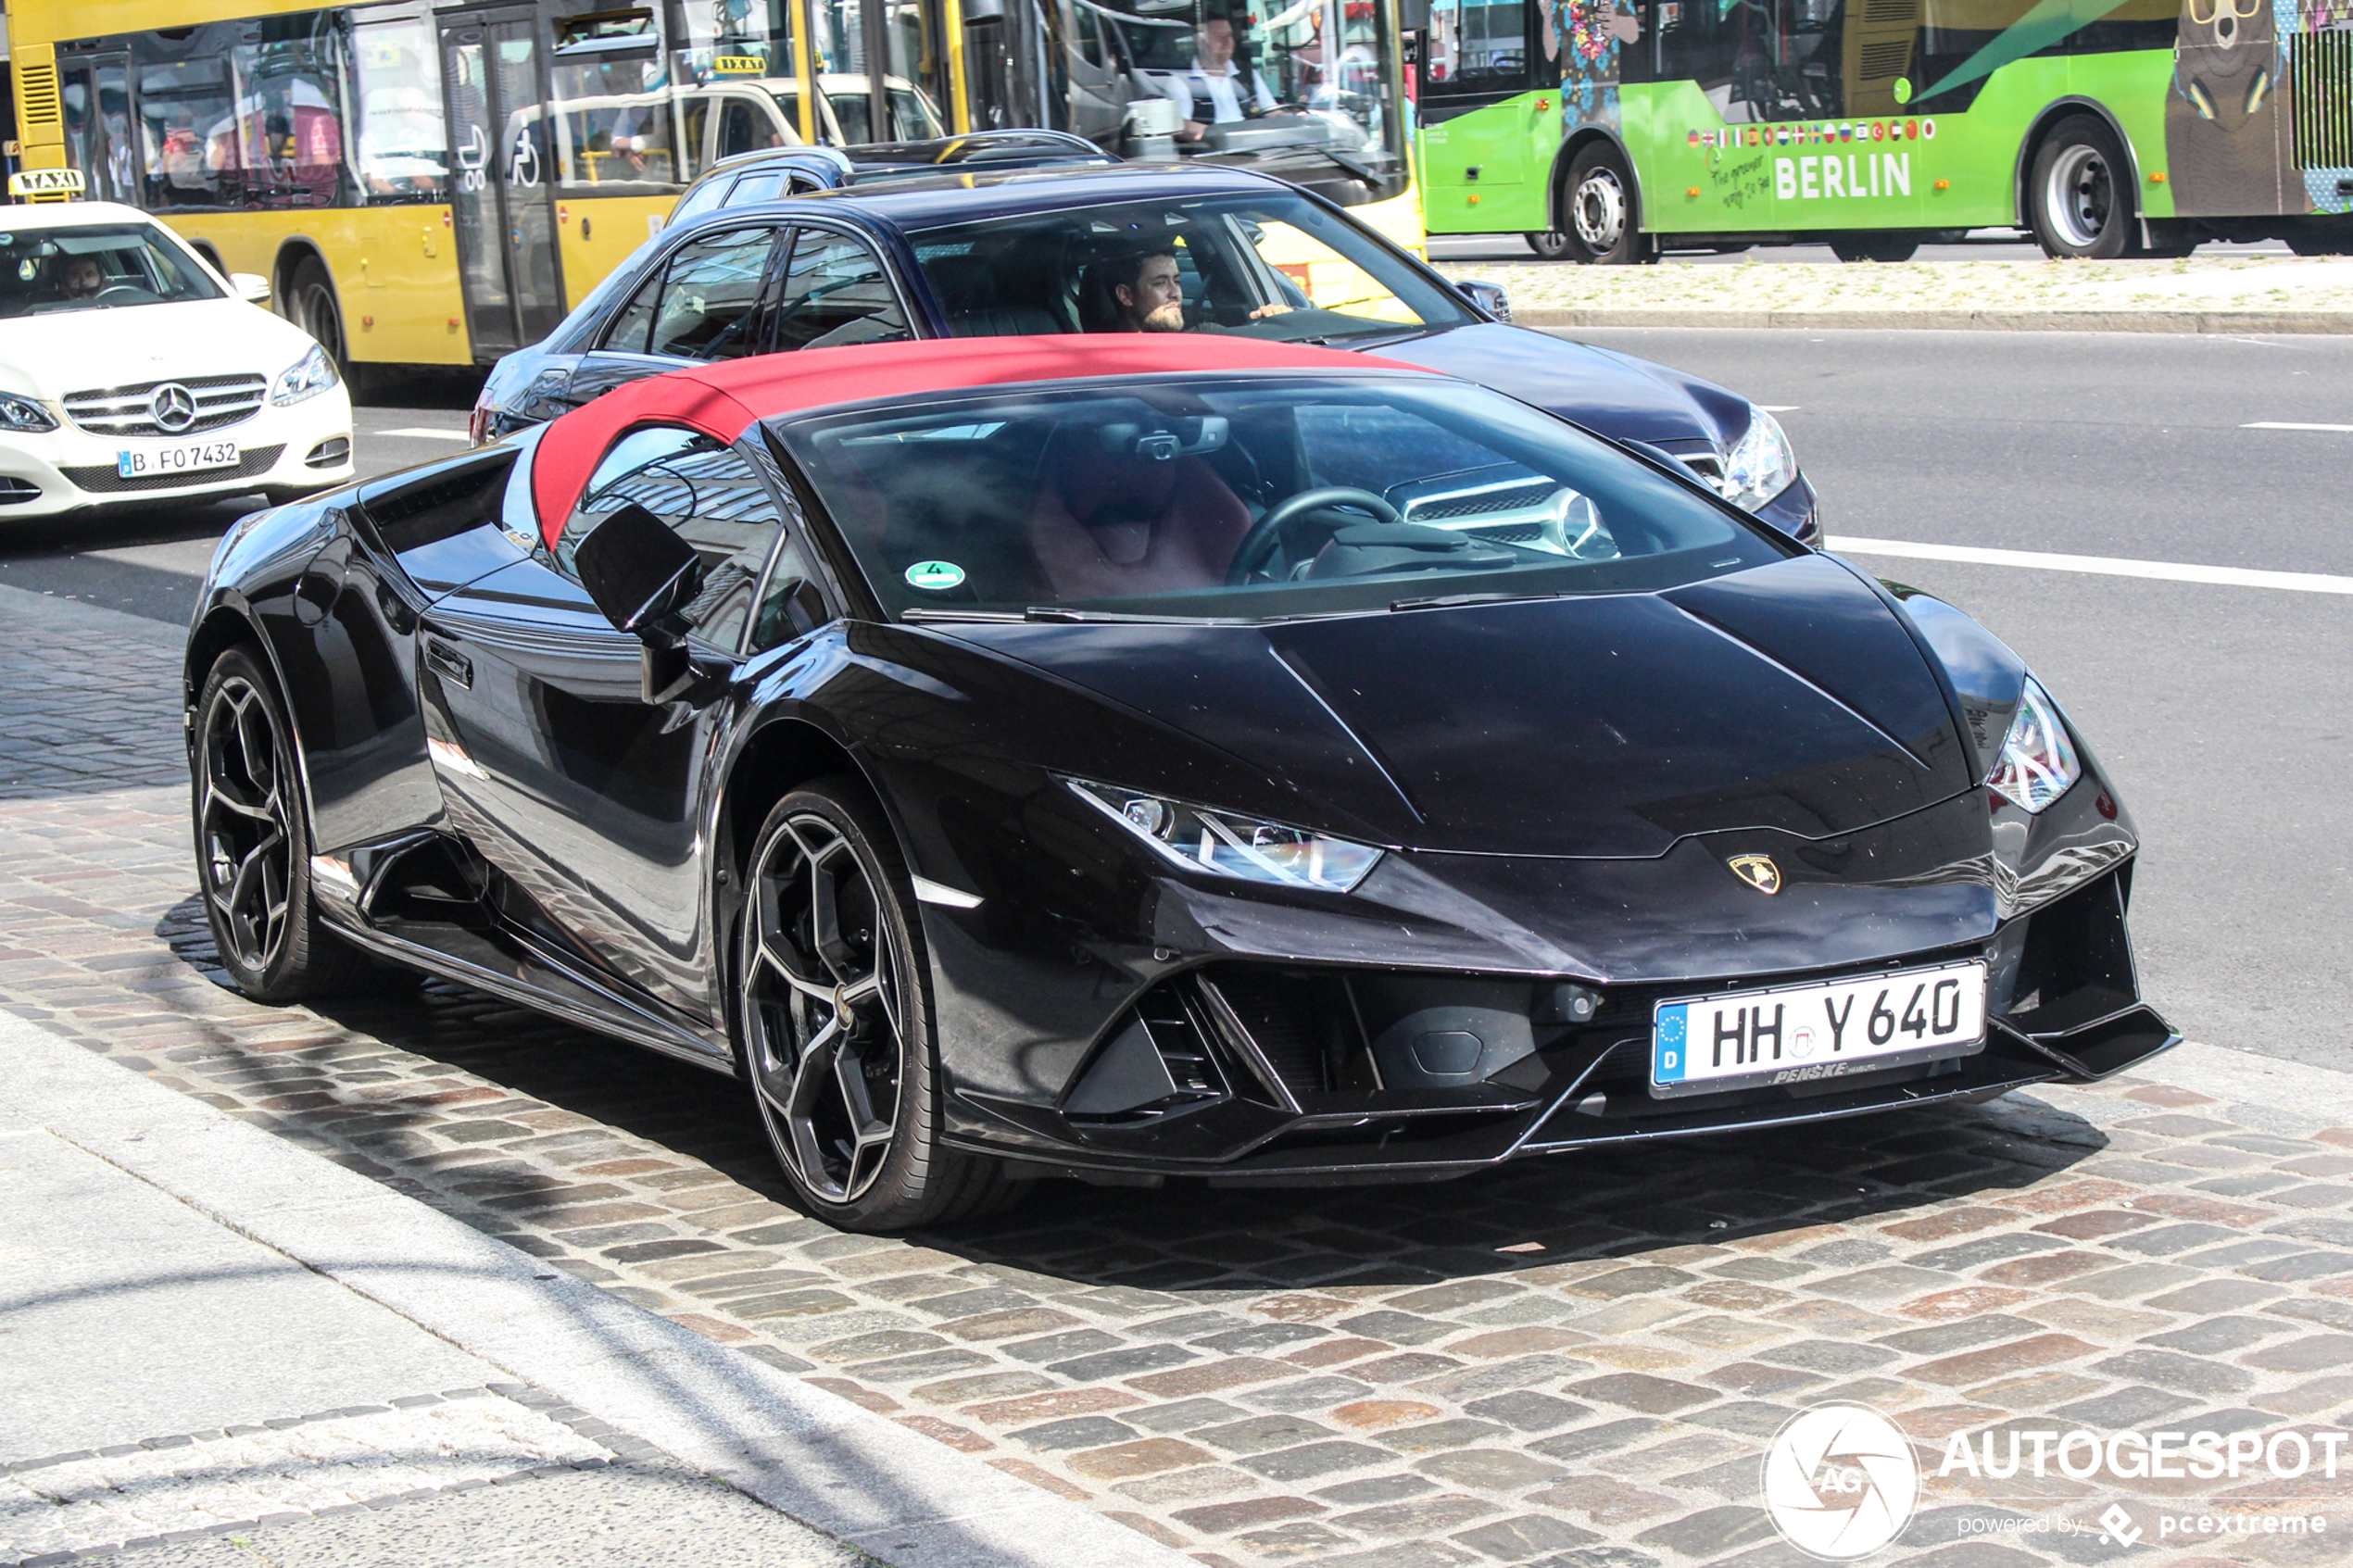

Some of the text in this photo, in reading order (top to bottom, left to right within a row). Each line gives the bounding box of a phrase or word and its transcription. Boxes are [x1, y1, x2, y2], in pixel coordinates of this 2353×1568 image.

[25, 172, 75, 188] TAXI
[1775, 153, 1911, 200] BERLIN
[133, 454, 145, 471] B
[191, 443, 236, 466] 7432
[927, 563, 942, 574] 4
[1713, 979, 1959, 1067] HH Y 640
[1664, 1051, 1678, 1069] D
[1773, 1062, 1847, 1085] PENSKE
